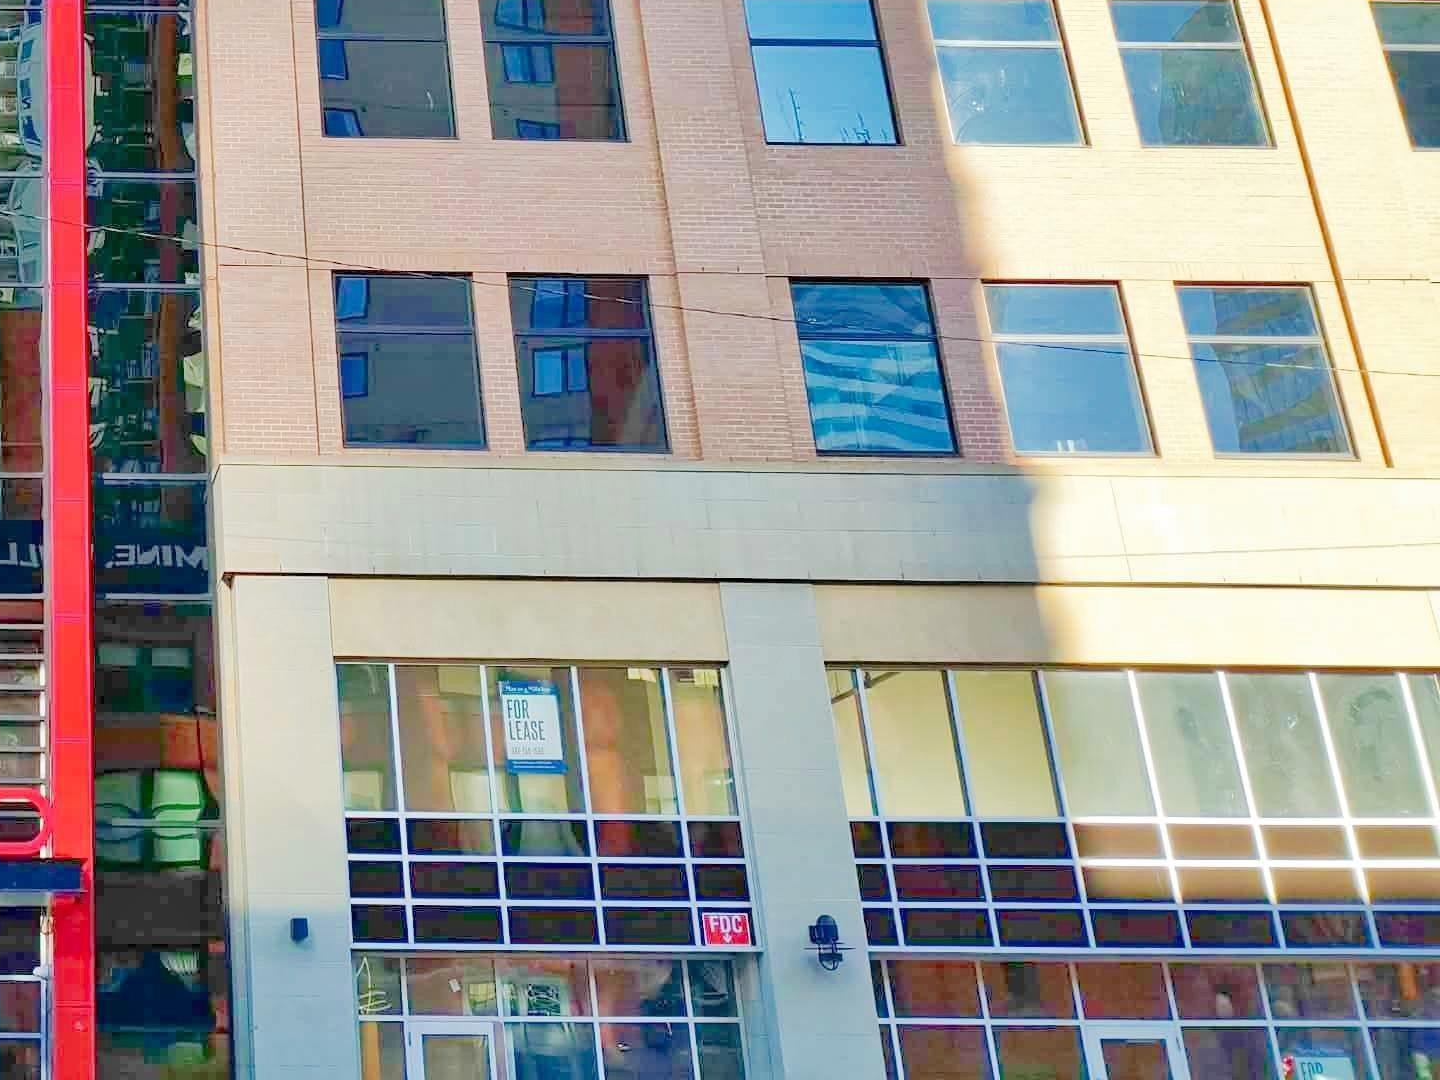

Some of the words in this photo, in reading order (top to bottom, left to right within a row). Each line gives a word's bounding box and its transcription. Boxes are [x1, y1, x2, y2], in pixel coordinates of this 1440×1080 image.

[507, 699, 530, 719] FOR
[508, 720, 546, 741] LEASE
[710, 915, 744, 933] FDC
